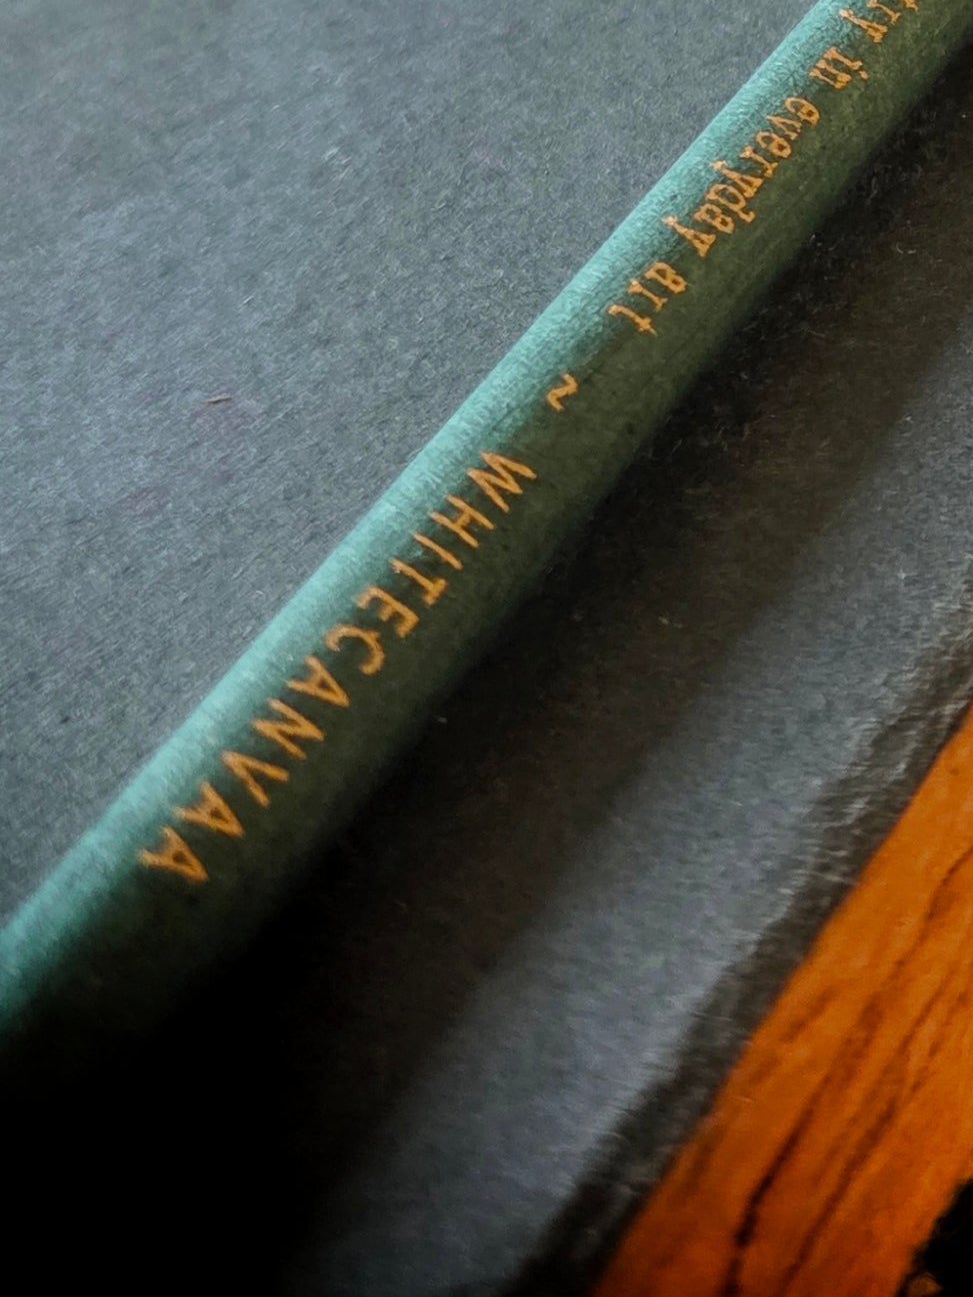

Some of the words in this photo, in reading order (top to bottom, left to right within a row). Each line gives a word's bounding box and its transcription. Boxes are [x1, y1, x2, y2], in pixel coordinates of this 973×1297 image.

[809, 46, 870, 89] in
[660, 95, 821, 257] everyday
[607, 260, 689, 335] art
[138, 451, 538, 882] WHITECANVAA
